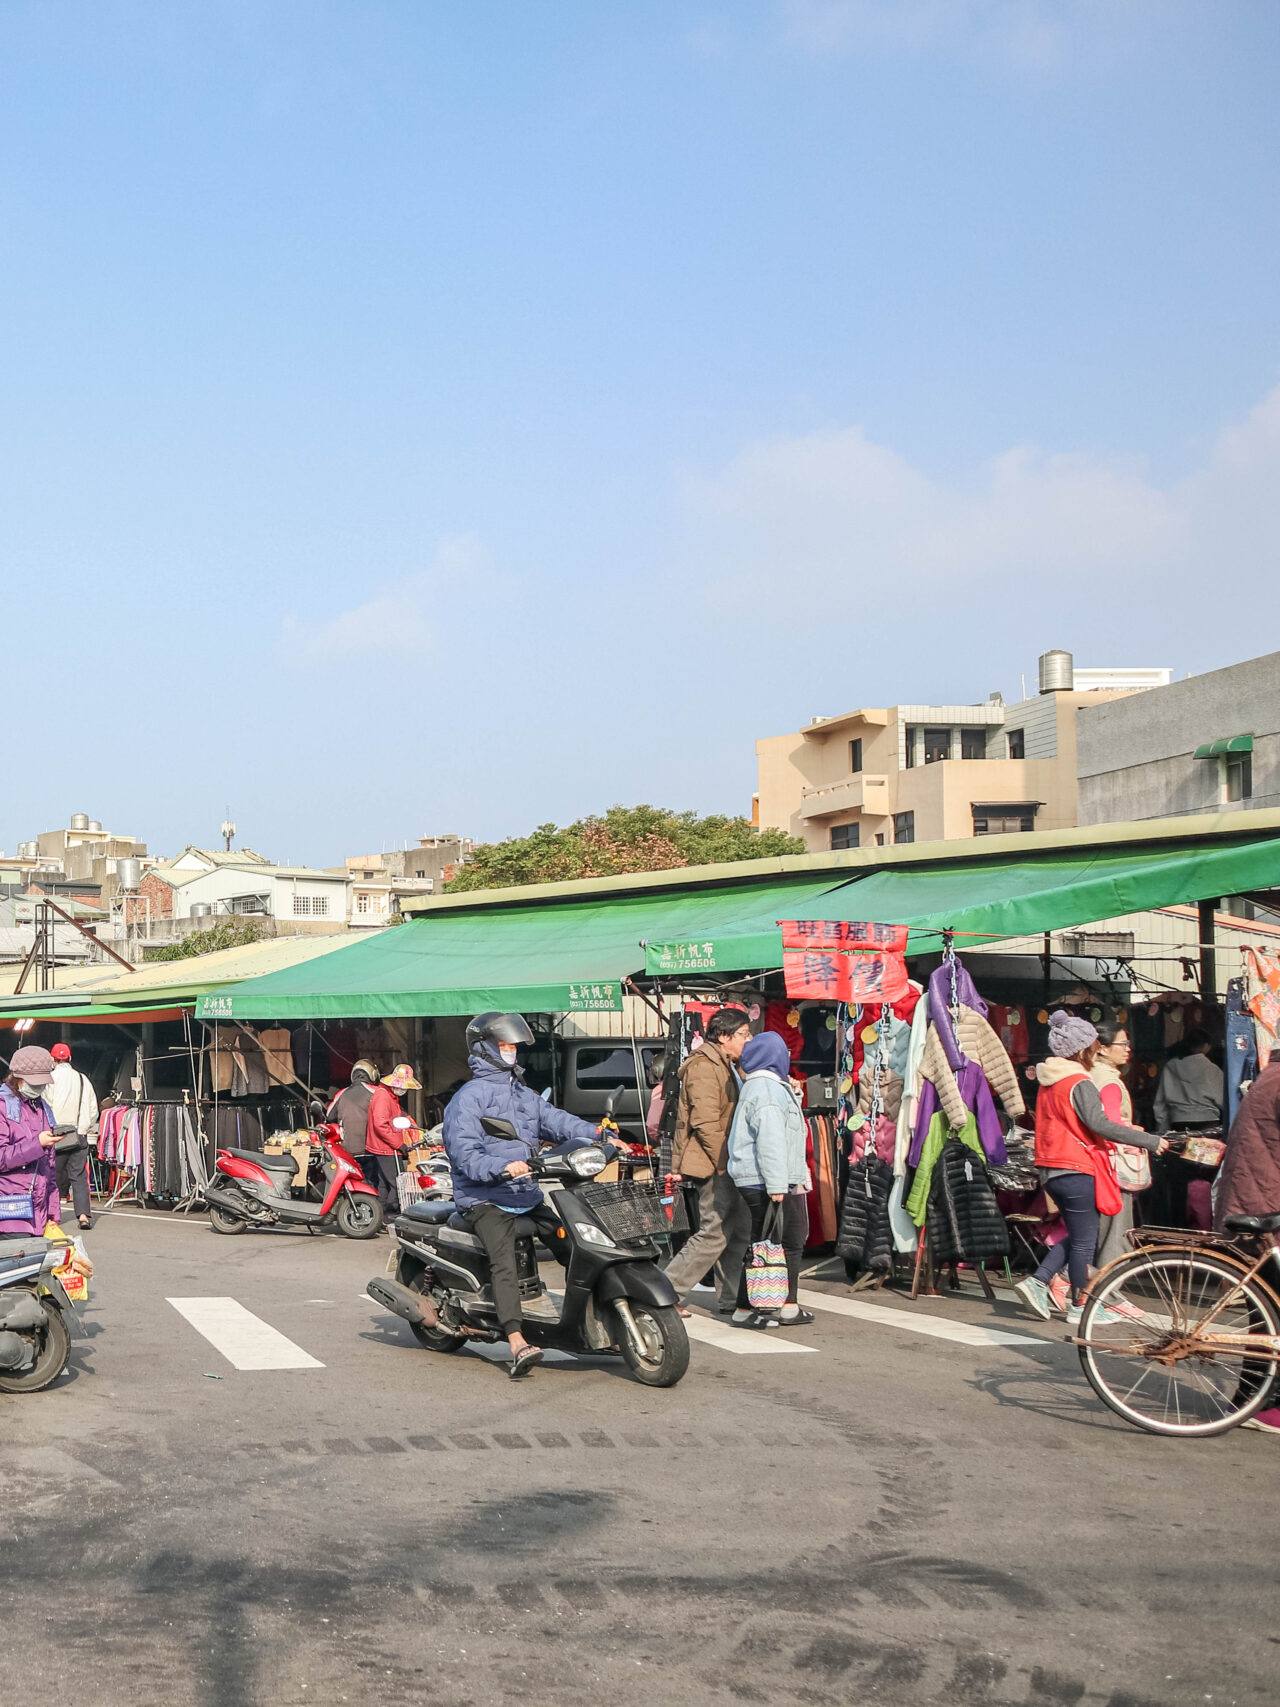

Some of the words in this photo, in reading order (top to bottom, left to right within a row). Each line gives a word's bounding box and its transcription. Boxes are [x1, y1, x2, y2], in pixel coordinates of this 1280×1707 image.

[660, 942, 715, 960] 嘉新帆布
[569, 984, 614, 1000] 嘉新帆布
